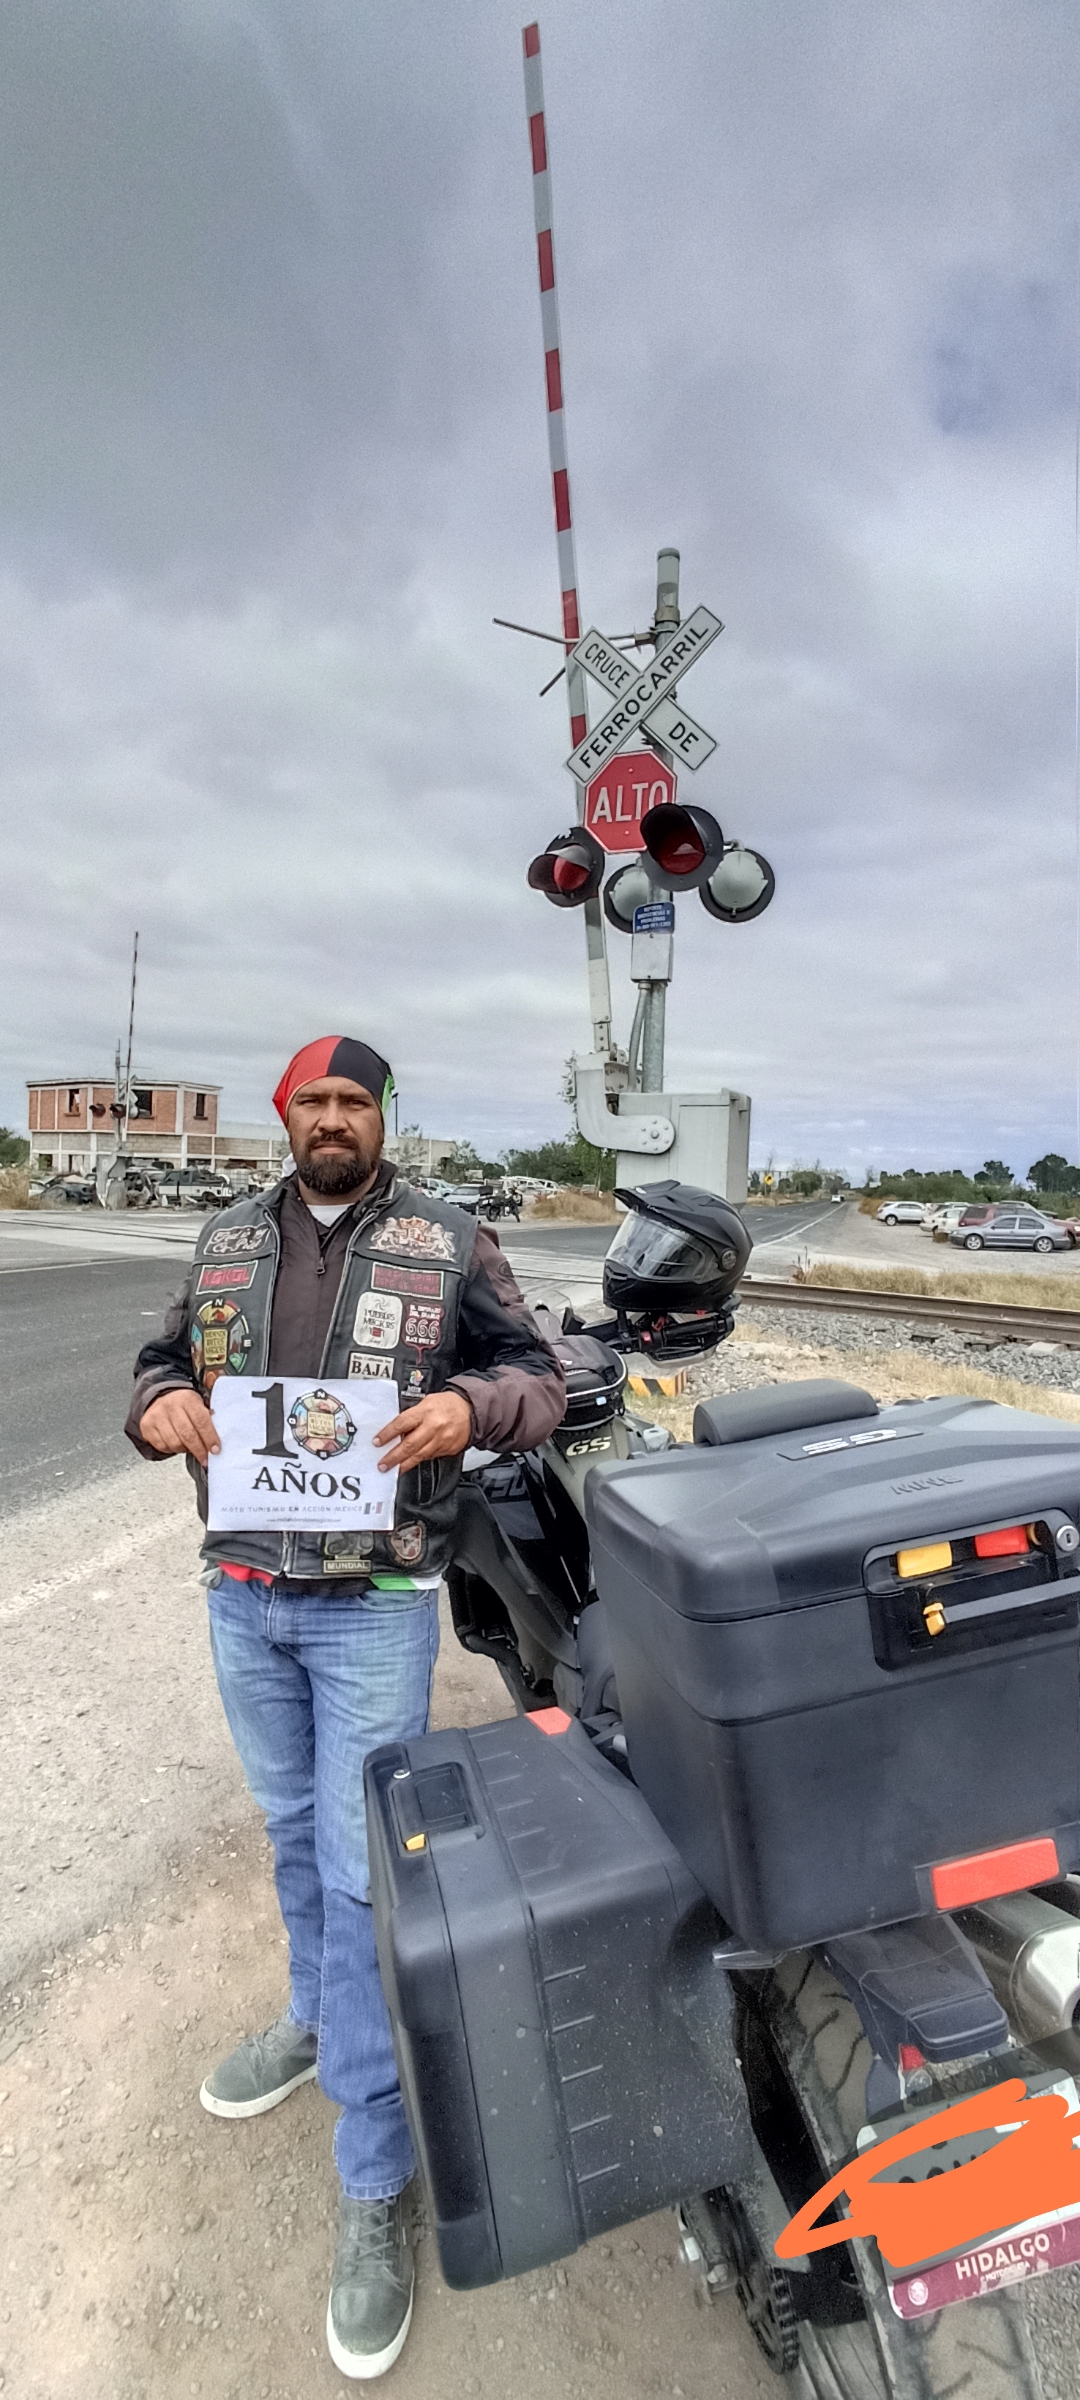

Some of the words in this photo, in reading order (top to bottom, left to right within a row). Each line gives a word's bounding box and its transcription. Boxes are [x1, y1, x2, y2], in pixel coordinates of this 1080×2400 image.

[584, 642, 631, 689] CRUCE
[579, 627, 709, 769] FERROCARRIL
[668, 721, 700, 753] DE
[591, 779, 668, 824] ALTO
[214, 1298, 223, 1306] N
[405, 1317, 440, 1338] 666
[351, 1360, 391, 1379] BAJA
[566, 1435, 613, 1457] GS
[251, 1462, 362, 1501] AÑOS
[326, 1561, 369, 1570] MUNDIAL
[955, 2233, 1050, 2280] HIDALGO
